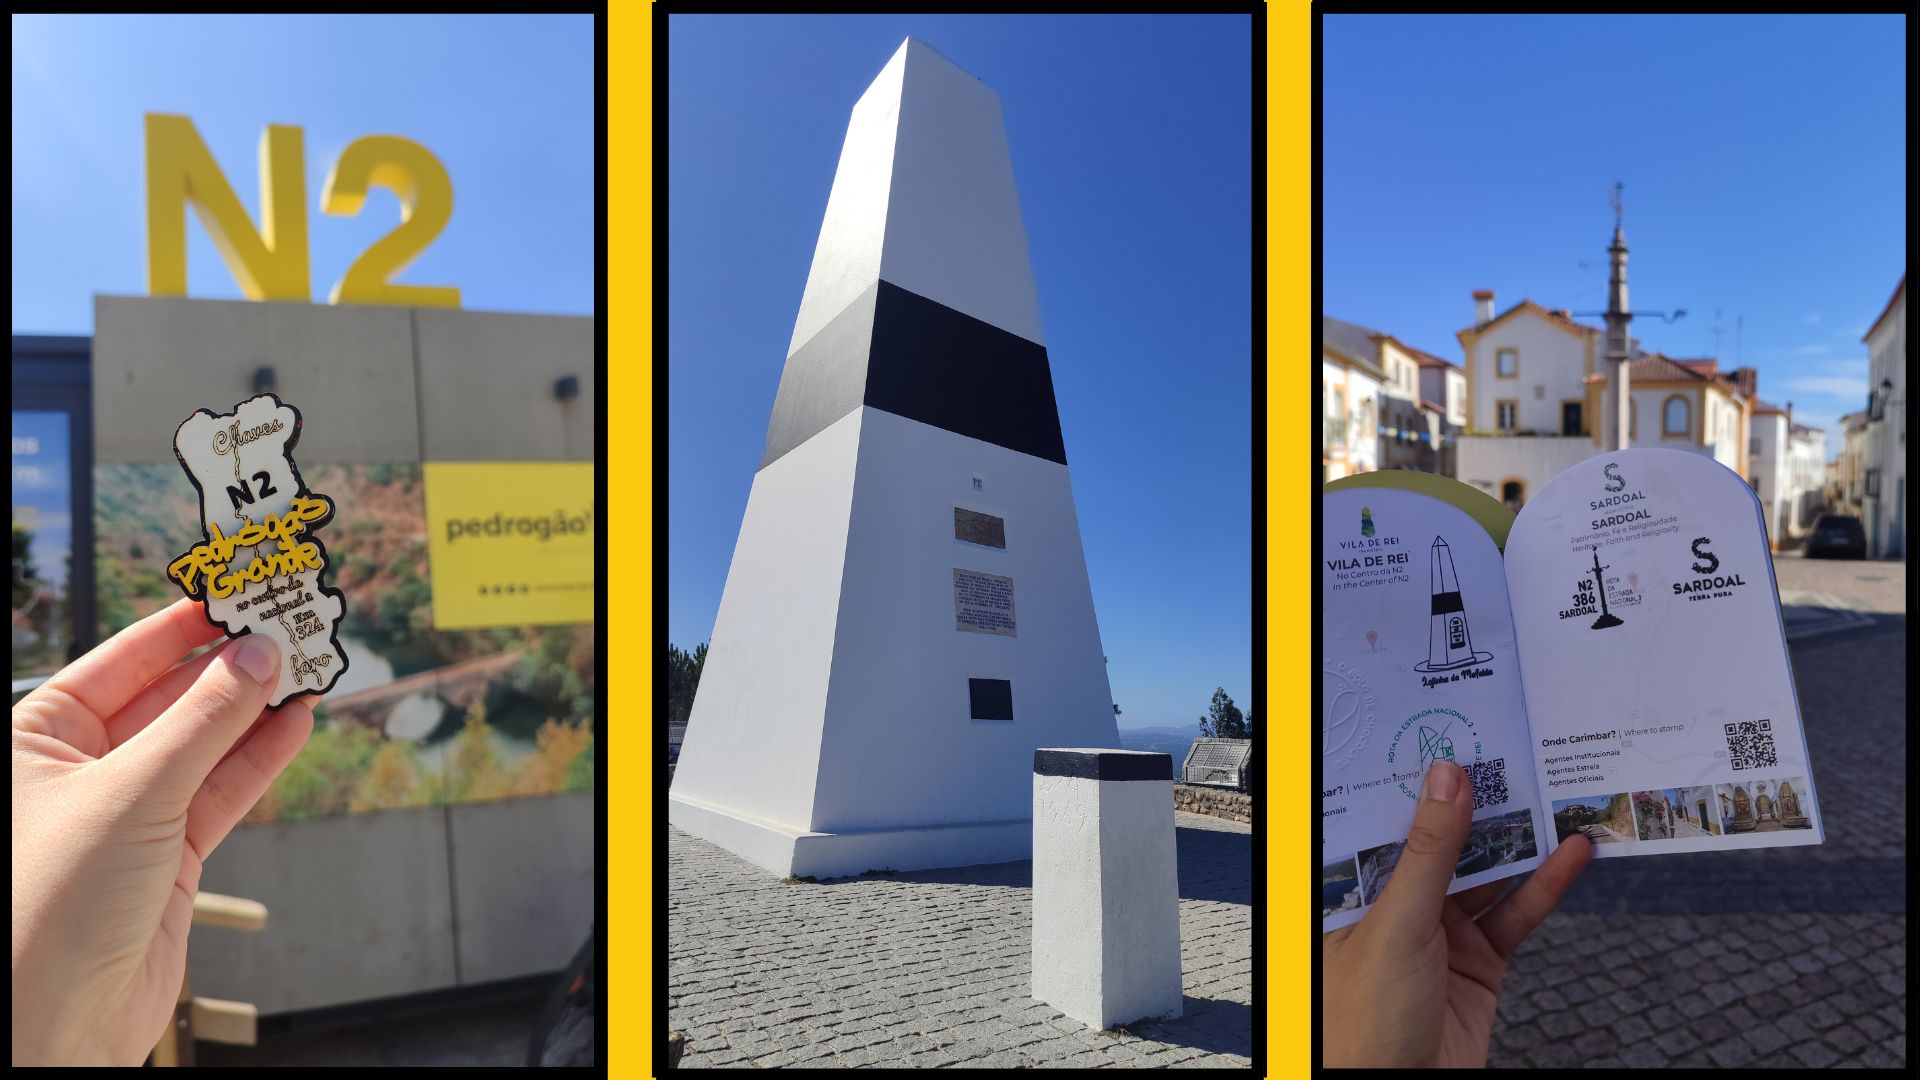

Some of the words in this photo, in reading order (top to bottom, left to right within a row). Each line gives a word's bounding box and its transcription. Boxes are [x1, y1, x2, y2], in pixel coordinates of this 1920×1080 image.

[143, 111, 462, 307] N2
[212, 419, 284, 456] Chaves
[226, 471, 278, 510] N2
[1590, 490, 1646, 511] SARDOAL
[1592, 509, 1652, 530] SARDOAL
[1629, 515, 1678, 532] Religiosidade
[1340, 540, 1364, 549] VILA
[1368, 538, 1380, 547] DE
[1384, 537, 1399, 546] REI
[1606, 534, 1625, 546] Faith
[1625, 533, 1640, 542] and
[1642, 525, 1680, 540] Religiosity
[207, 542, 322, 599] Grande
[1327, 558, 1361, 571] VILA
[1364, 555, 1383, 567] DE
[1387, 552, 1409, 565] REI
[1333, 583, 1341, 591] In
[1343, 580, 1358, 590] the
[1360, 577, 1387, 588] Center
[1388, 574, 1398, 584] of
[1398, 574, 1410, 583] N2
[1337, 572, 1349, 581] No
[1351, 569, 1379, 580] Centro
[1381, 566, 1391, 575] da
[1393, 565, 1404, 574] N2
[1578, 579, 1594, 592] N2
[1673, 574, 1746, 595] SARDOAL
[1572, 591, 1596, 607] 386
[1688, 594, 1712, 602] TERRA
[1713, 591, 1733, 599] PURA
[236, 601, 250, 612] no
[1559, 605, 1599, 620] SARDOAL
[295, 617, 325, 641] 324
[1388, 742, 1398, 763] ROTA
[1393, 730, 1403, 742] DA
[1401, 708, 1433, 731] ESTRADA
[1434, 707, 1468, 725] NACIONAL
[1541, 738, 1567, 748] Onde
[1569, 730, 1616, 745] Carimbar?
[1624, 729, 1650, 738] Where
[1650, 726, 1657, 734] to
[1659, 723, 1685, 734] stamp
[1544, 755, 1573, 765] Agentes
[1574, 749, 1621, 761] Institucionais
[1546, 766, 1575, 777] Agentes
[1576, 763, 1600, 773] Estrela
[1353, 779, 1381, 791] Where
[1383, 777, 1391, 785] to
[1392, 771, 1420, 784] stamp
[1548, 777, 1577, 788] Agentes
[1578, 774, 1605, 784] Oficiais
